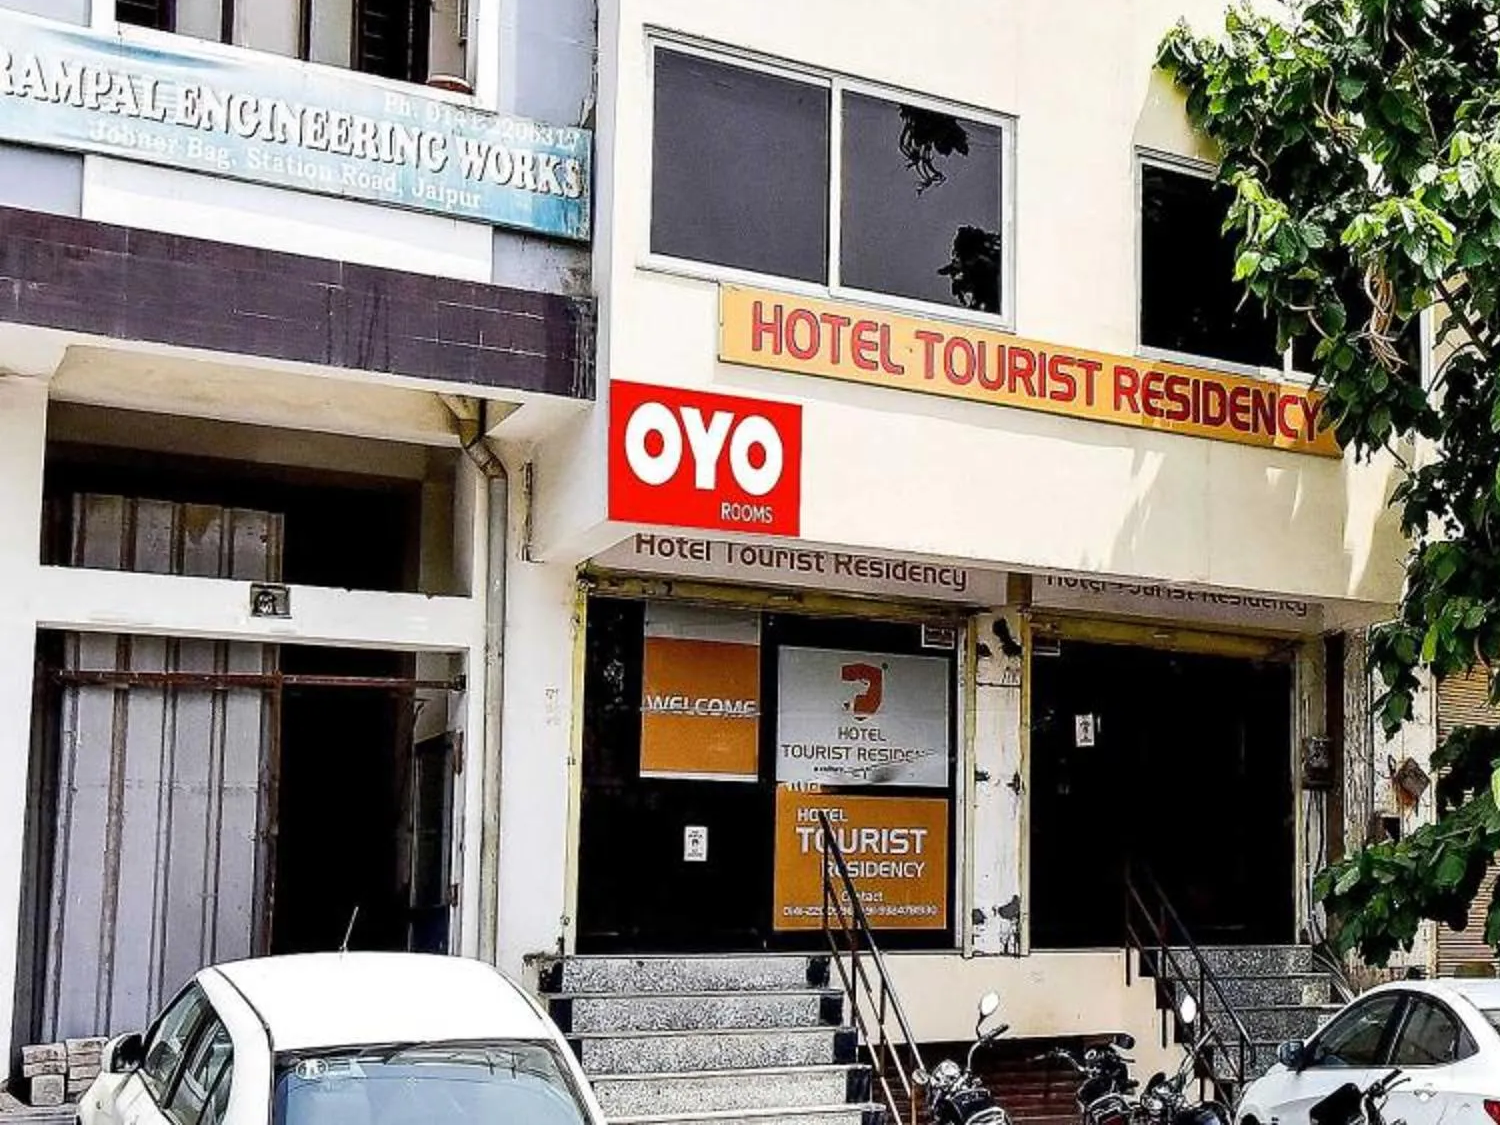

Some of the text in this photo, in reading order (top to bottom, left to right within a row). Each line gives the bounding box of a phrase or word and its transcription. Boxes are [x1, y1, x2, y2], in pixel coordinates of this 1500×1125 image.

[175, 80, 449, 173] ENGINEERING
[456, 136, 584, 199] WORKS
[247, 147, 332, 182] Station
[411, 179, 481, 209] Jaipur
[752, 300, 1321, 443] HOTEL TOURIST RESIDENCY
[625, 401, 784, 496] OYO
[720, 501, 774, 524] ROOMS
[634, 532, 967, 592] Hotel Tourist Residency
[647, 695, 757, 718] WELCOME
[782, 744, 853, 761] TOURIST
[838, 726, 886, 742] HOTEL
[797, 808, 849, 823] HOTEL
